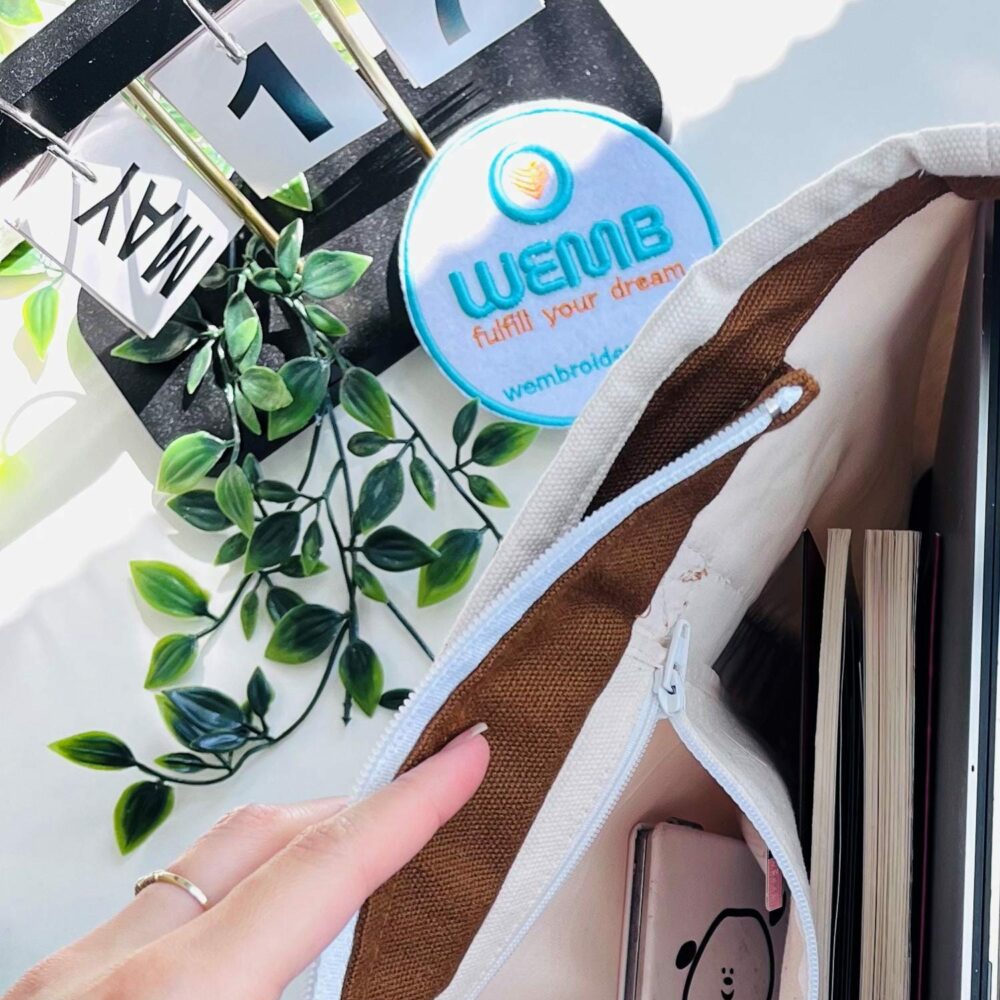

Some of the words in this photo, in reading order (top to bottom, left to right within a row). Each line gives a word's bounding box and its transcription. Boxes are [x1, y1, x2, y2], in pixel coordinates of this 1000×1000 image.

[227, 41, 335, 143] 1
[73, 161, 214, 299] MAY
[447, 203, 674, 319] WEMB
[471, 308, 534, 348] fulfill
[541, 292, 599, 328] your
[610, 261, 687, 300] dream
[502, 343, 630, 402] wembroide
